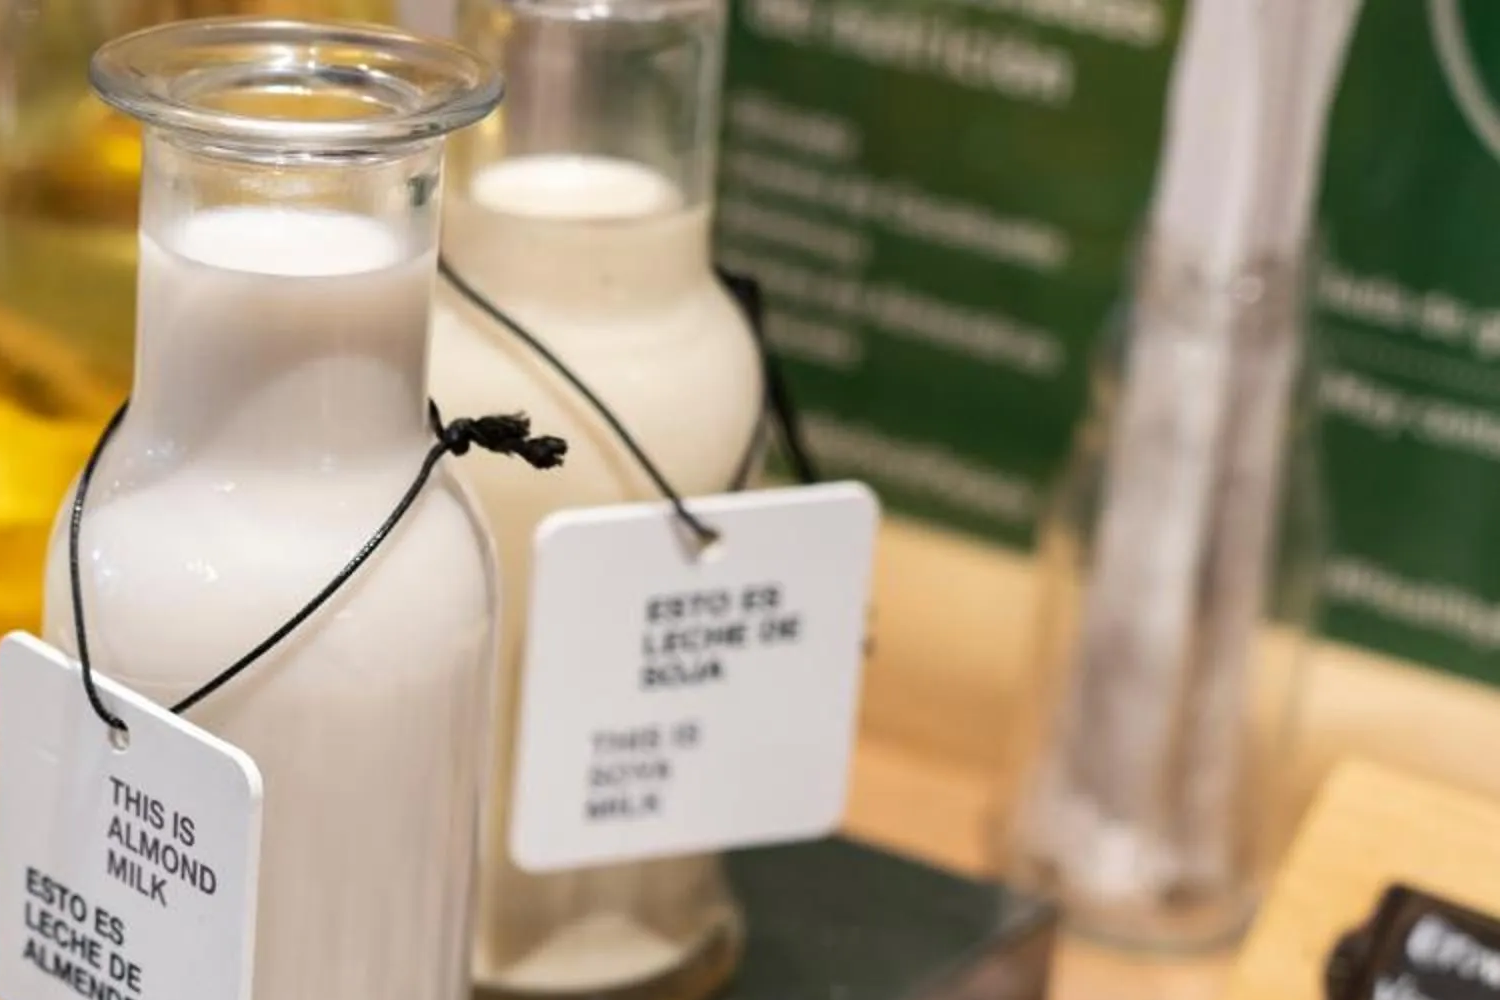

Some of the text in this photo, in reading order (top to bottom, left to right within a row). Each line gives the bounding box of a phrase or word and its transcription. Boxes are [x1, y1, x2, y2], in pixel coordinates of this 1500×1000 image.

[109, 776, 196, 847] THIS IS
[106, 851, 168, 908] MILK
[107, 816, 218, 895] ALMOND
[25, 867, 126, 946] ESTO ES
[24, 901, 142, 993] LECHE DE
